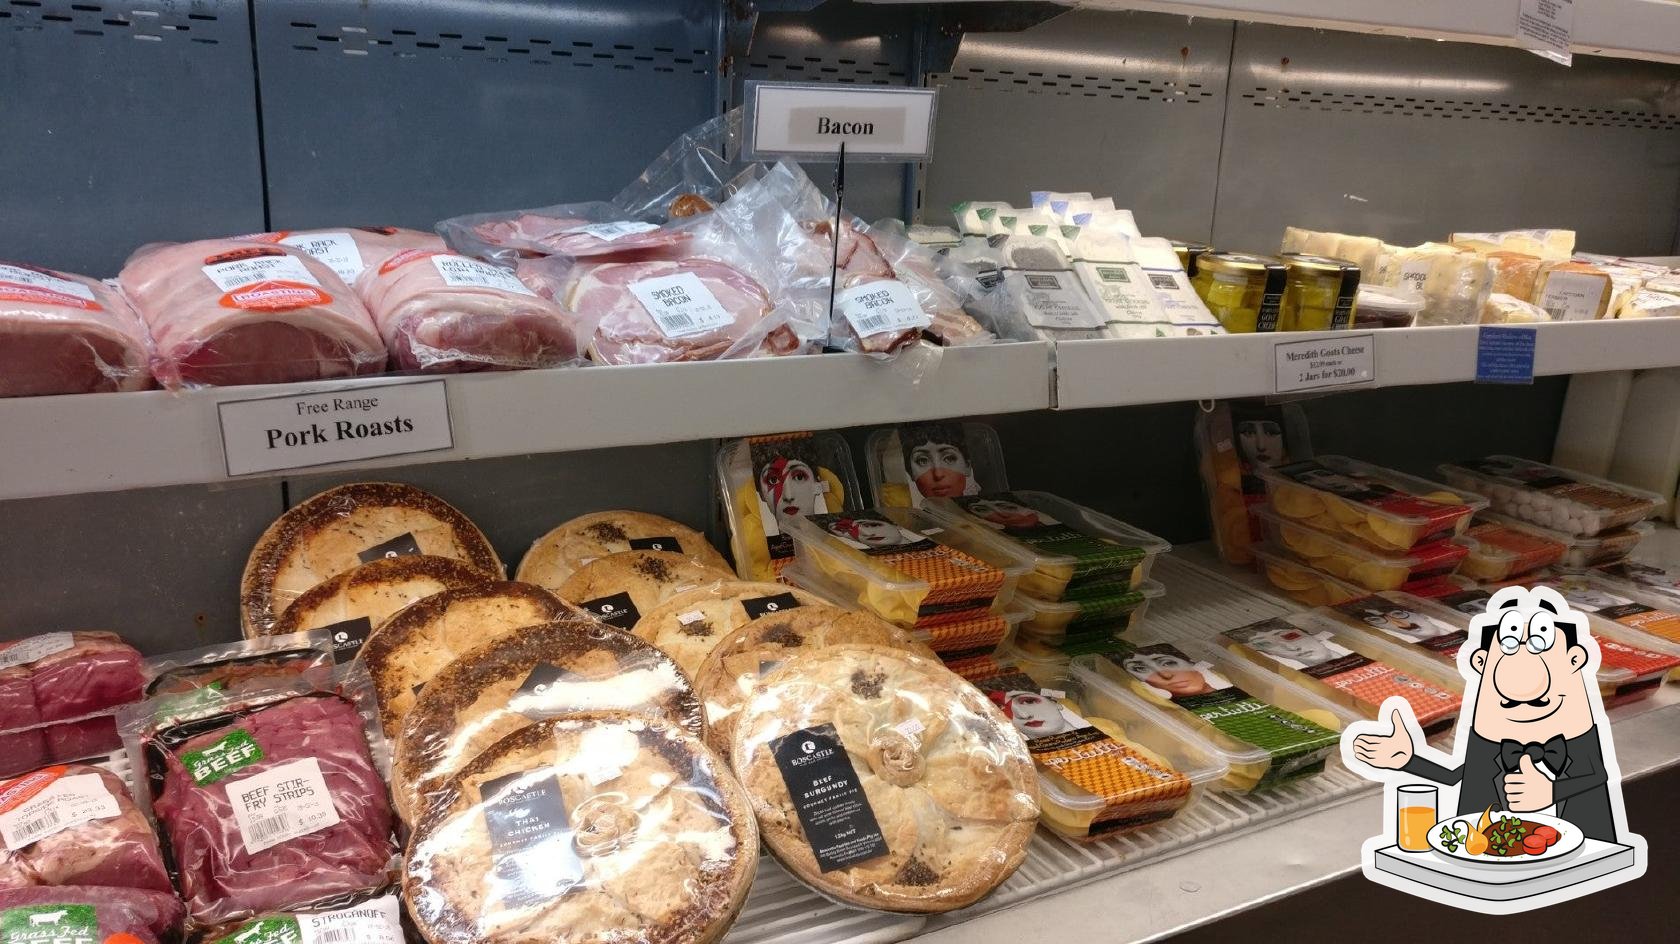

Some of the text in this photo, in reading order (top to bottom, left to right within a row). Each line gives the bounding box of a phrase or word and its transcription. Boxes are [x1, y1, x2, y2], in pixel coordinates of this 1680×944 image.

[817, 117, 874, 135] Bacon
[651, 285, 685, 300] SMOKED
[662, 294, 692, 307] BACON
[855, 290, 890, 304] SMOKED
[864, 297, 895, 309] BACON
[1286, 345, 1365, 361] Meredith Goats Cheese
[1305, 372, 1320, 381] Jars
[1322, 370, 1332, 379] for
[1333, 367, 1356, 378] $20.00
[296, 397, 379, 416] Free Range
[264, 415, 415, 450] Pork Roasts
[194, 743, 256, 781] BEEF
[791, 748, 834, 766] BOSCASTLE
[804, 780, 848, 798] BURGUNDY
[813, 775, 832, 787] BEEF
[242, 778, 310, 803] BEEF STIR-
[245, 786, 315, 812] FRY STRIPS
[507, 822, 550, 837] CHICKEN
[515, 816, 539, 827] THAI
[312, 909, 387, 927] STROGANOFF
[10, 928, 57, 944] Grass
[57, 926, 89, 938] Fed
